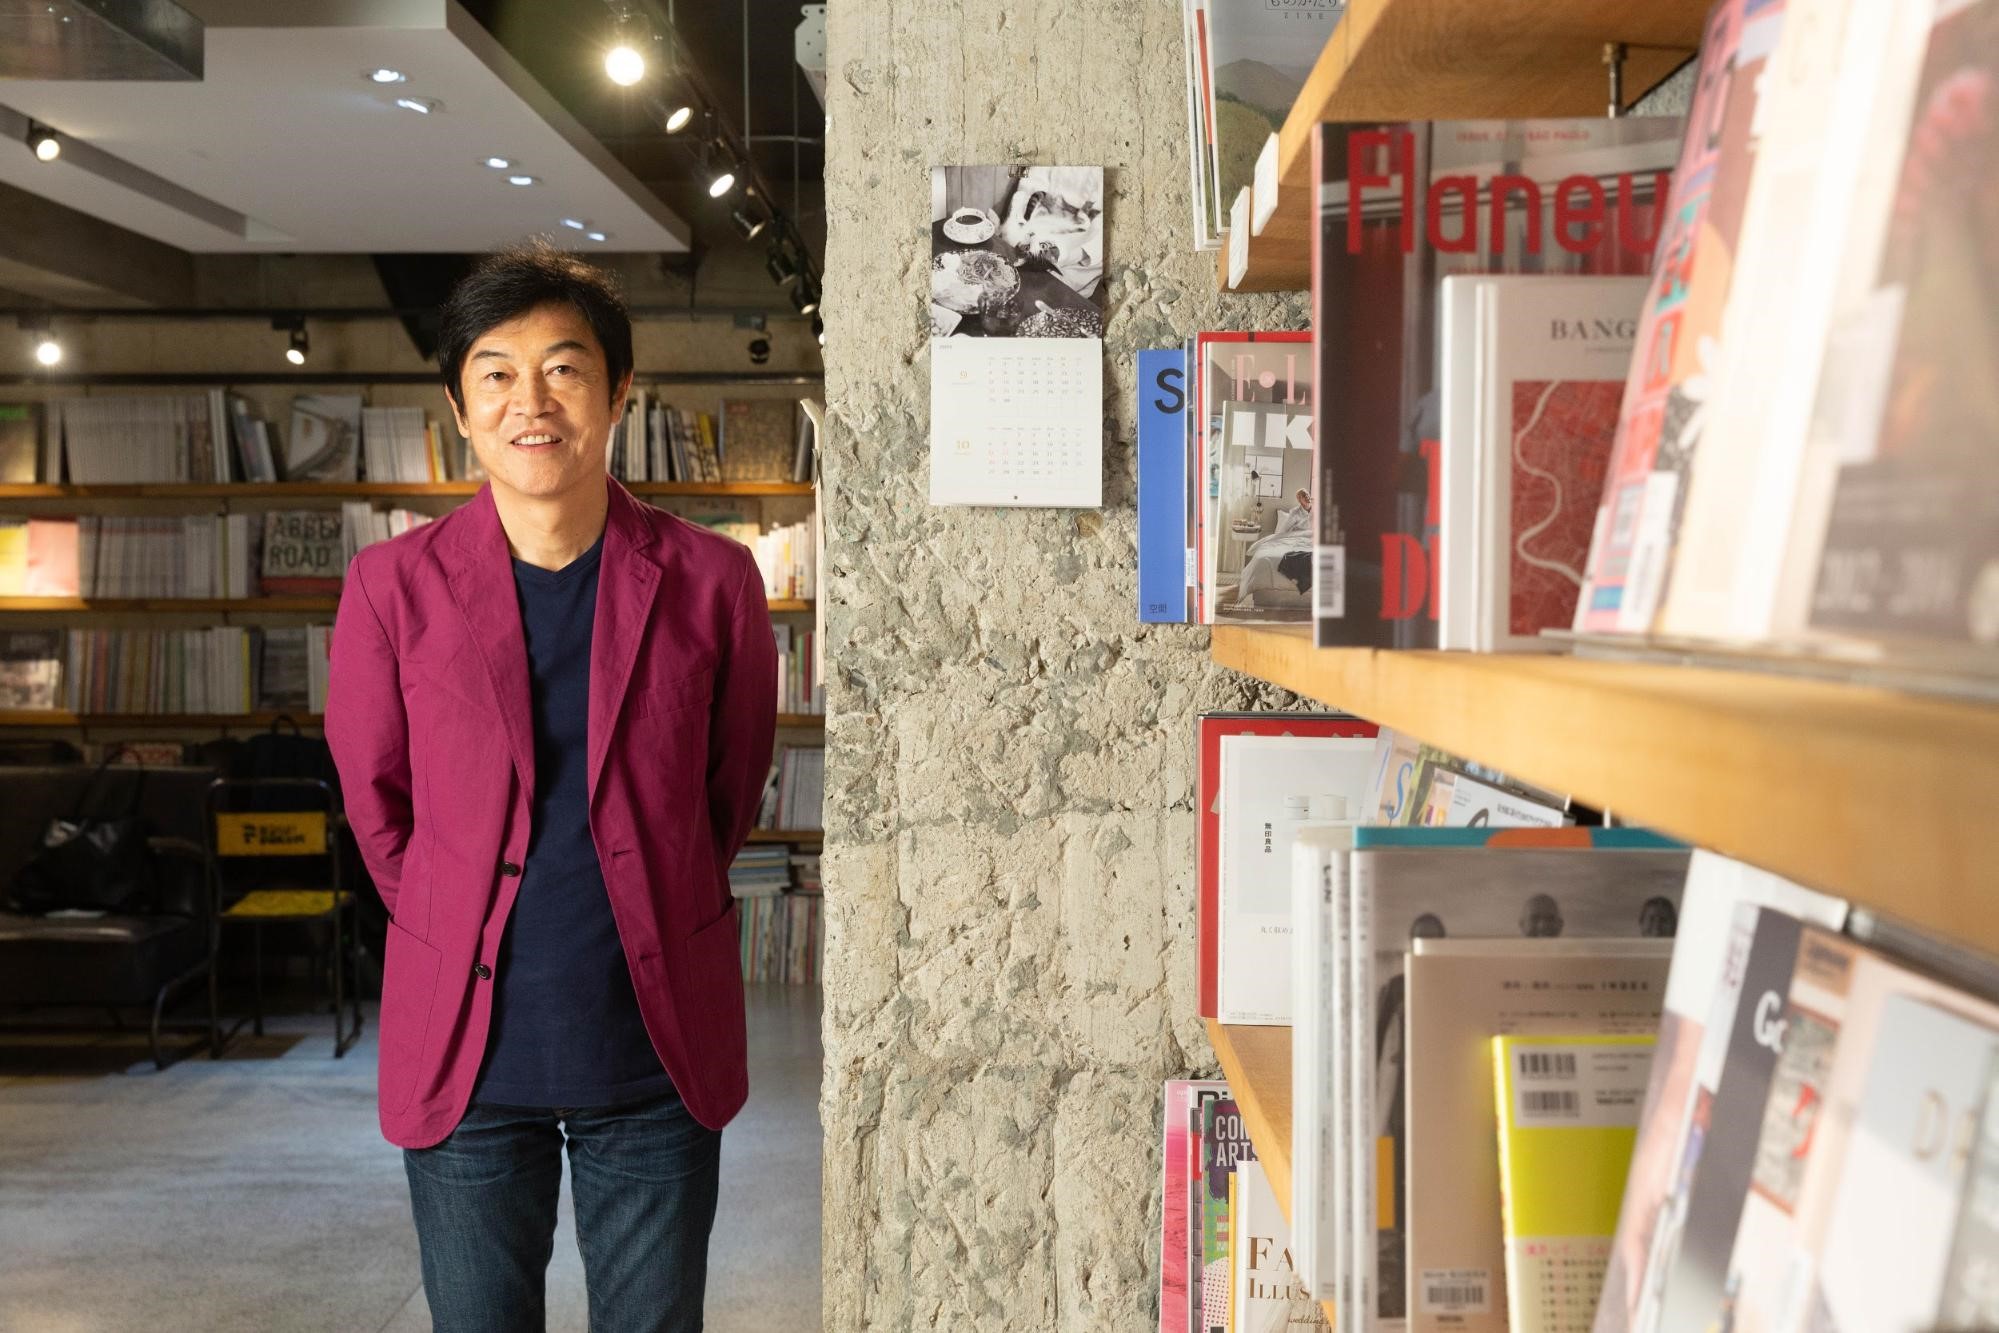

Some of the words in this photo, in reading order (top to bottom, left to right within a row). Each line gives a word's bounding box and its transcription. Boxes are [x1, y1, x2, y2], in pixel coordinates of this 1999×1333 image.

[270, 544, 330, 568] ROAD
[1264, 822, 1272, 853] 無印良品
